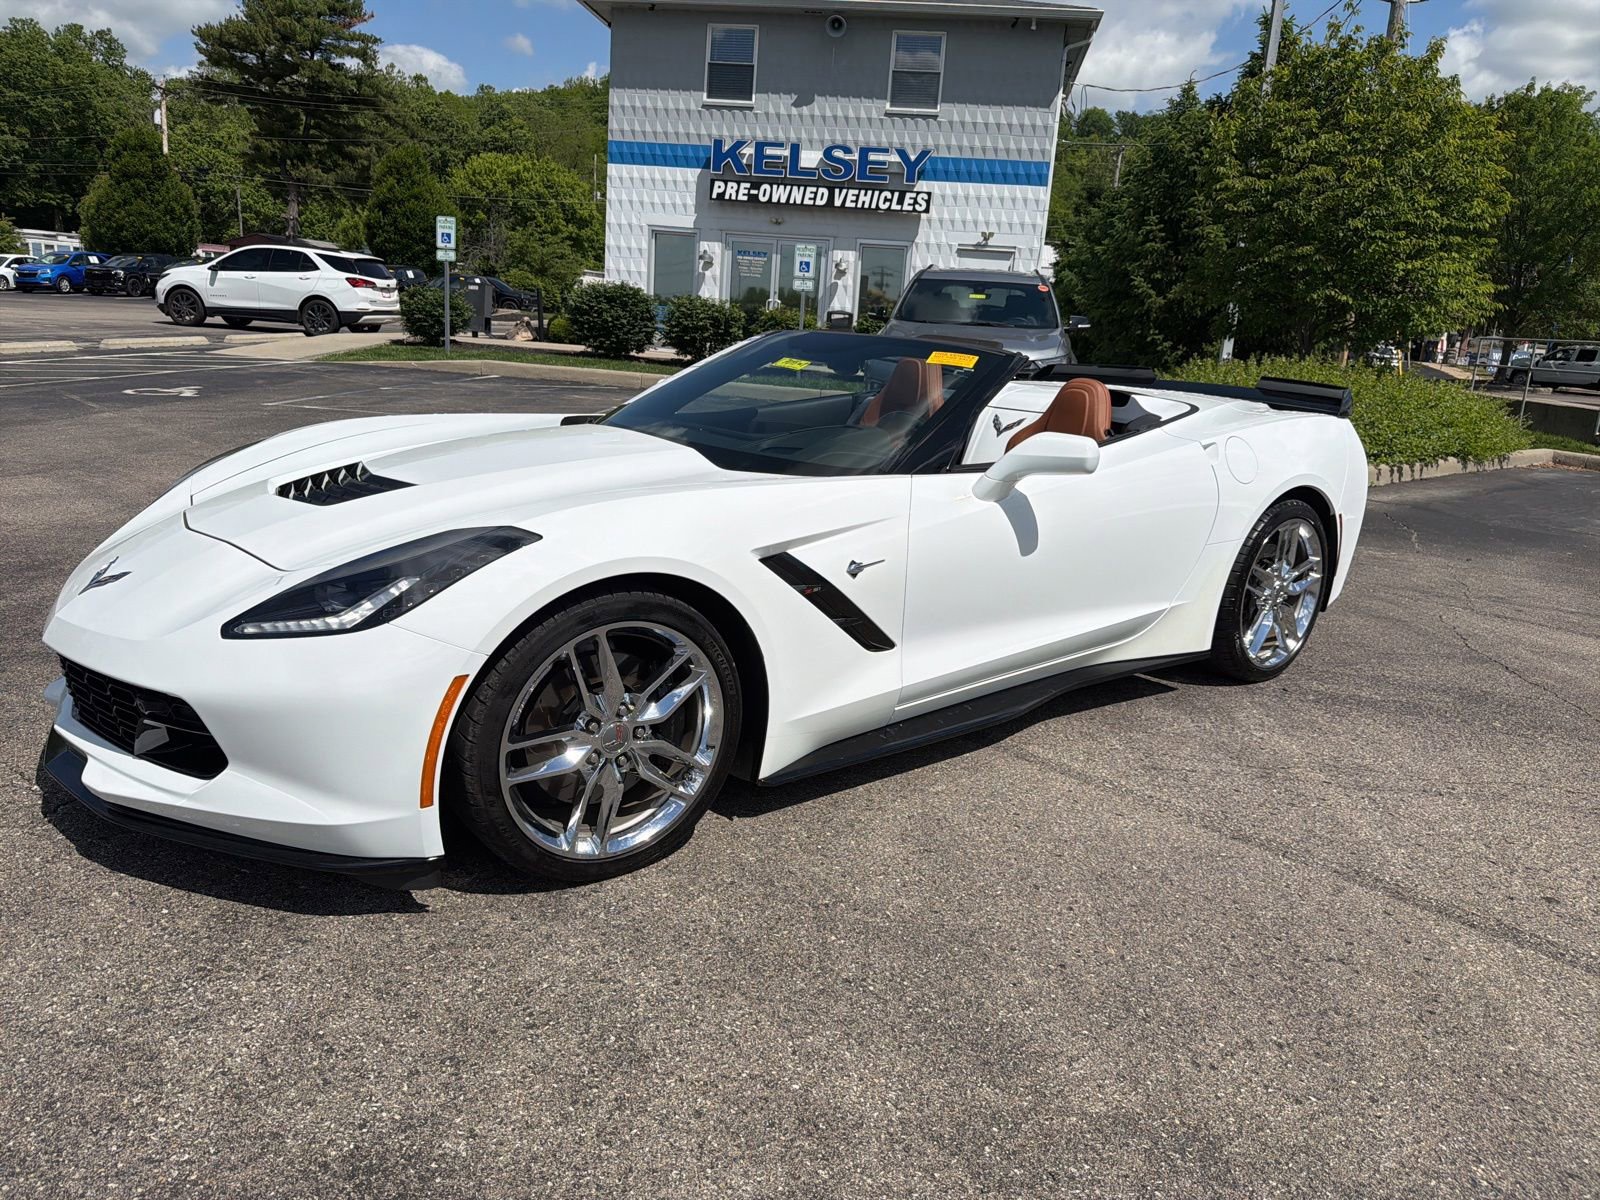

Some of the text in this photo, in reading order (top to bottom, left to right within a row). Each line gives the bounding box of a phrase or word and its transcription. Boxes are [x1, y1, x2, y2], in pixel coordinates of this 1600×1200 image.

[710, 138, 934, 184] KELSEY
[711, 181, 929, 211] PRE-OWNED VEHICLES
[706, 639, 736, 694] MICHELIN
